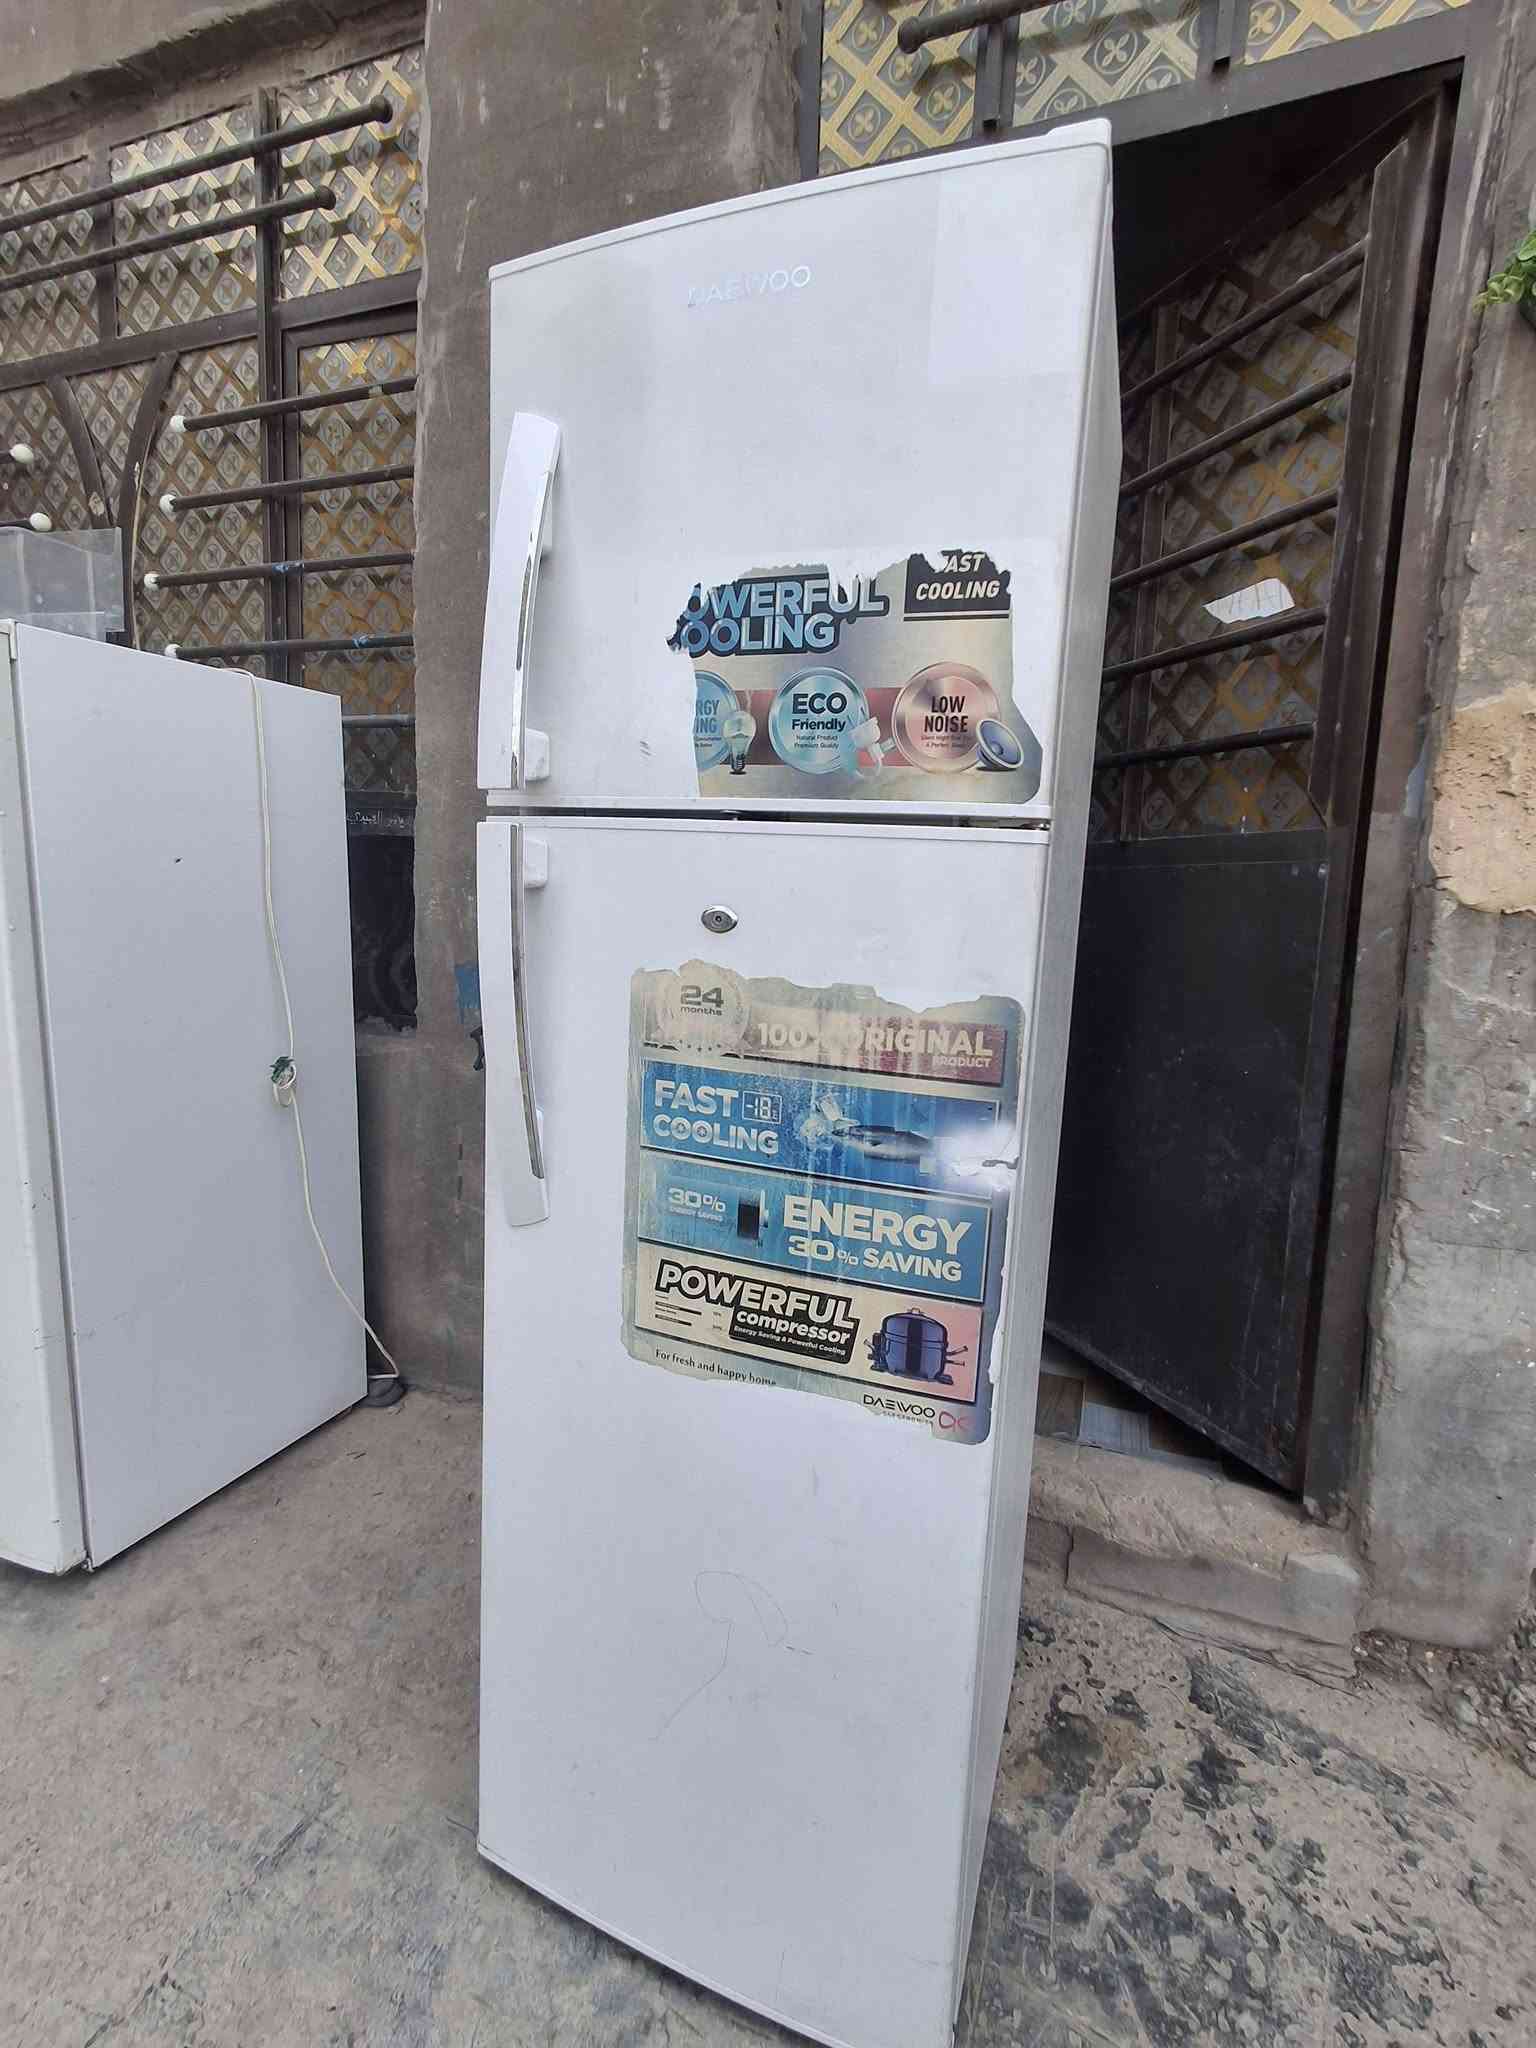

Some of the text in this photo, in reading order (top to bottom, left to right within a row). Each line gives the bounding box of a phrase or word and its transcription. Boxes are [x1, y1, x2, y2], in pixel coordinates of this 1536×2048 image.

[941, 553, 986, 573] AST
[684, 577, 885, 621] OWERFUL
[916, 580, 1000, 601] COOLING
[679, 612, 836, 654] OOLING
[792, 692, 847, 714] ECO
[931, 695, 966, 713] LOW
[792, 718, 846, 732] Friendly
[924, 715, 968, 733] NOISE
[680, 984, 724, 1008] 24
[680, 1005, 723, 1017] months
[931, 1055, 992, 1068] PRODUCT
[655, 1079, 739, 1118] FAST
[653, 1113, 779, 1154] COOLING
[668, 1187, 726, 1213] 30%
[783, 1194, 972, 1255] ENERGY
[863, 1247, 962, 1282] SAVING
[658, 1261, 857, 1330] POWERFUL
[734, 1325, 757, 1337] Energy
[819, 1345, 847, 1356] Cooling
[736, 1310, 851, 1345] compressor
[655, 1349, 670, 1361] For
[672, 1353, 695, 1368] fresh
[697, 1361, 716, 1373] and
[717, 1365, 747, 1382] happy
[863, 1394, 935, 1418] DAEWOO
